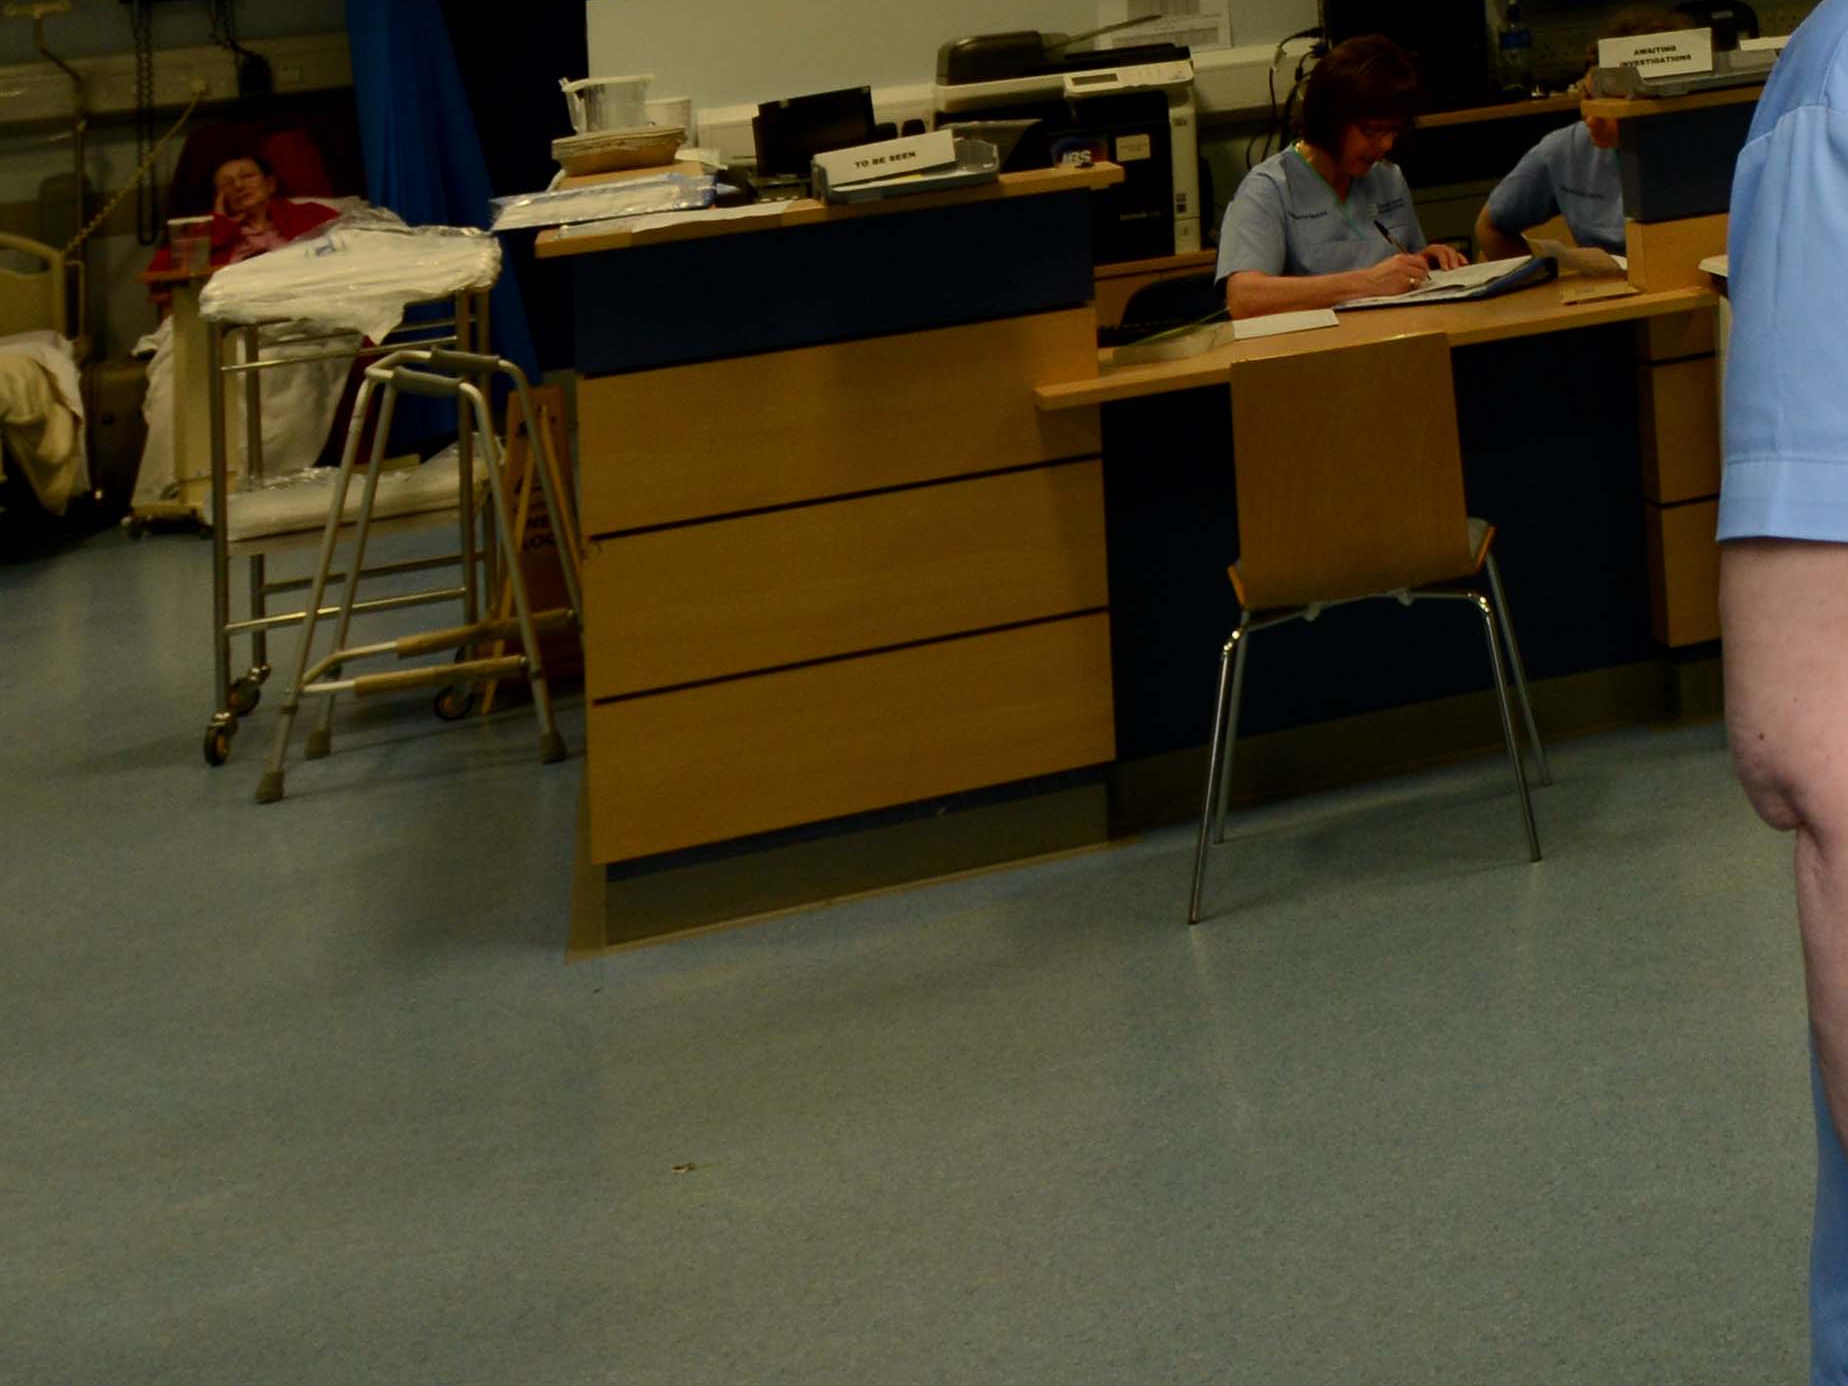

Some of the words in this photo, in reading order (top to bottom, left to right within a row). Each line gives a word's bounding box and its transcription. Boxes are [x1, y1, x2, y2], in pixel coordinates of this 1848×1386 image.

[1633, 45, 1677, 57] AWAITING
[854, 160, 869, 169] TO
[872, 156, 886, 165] BE
